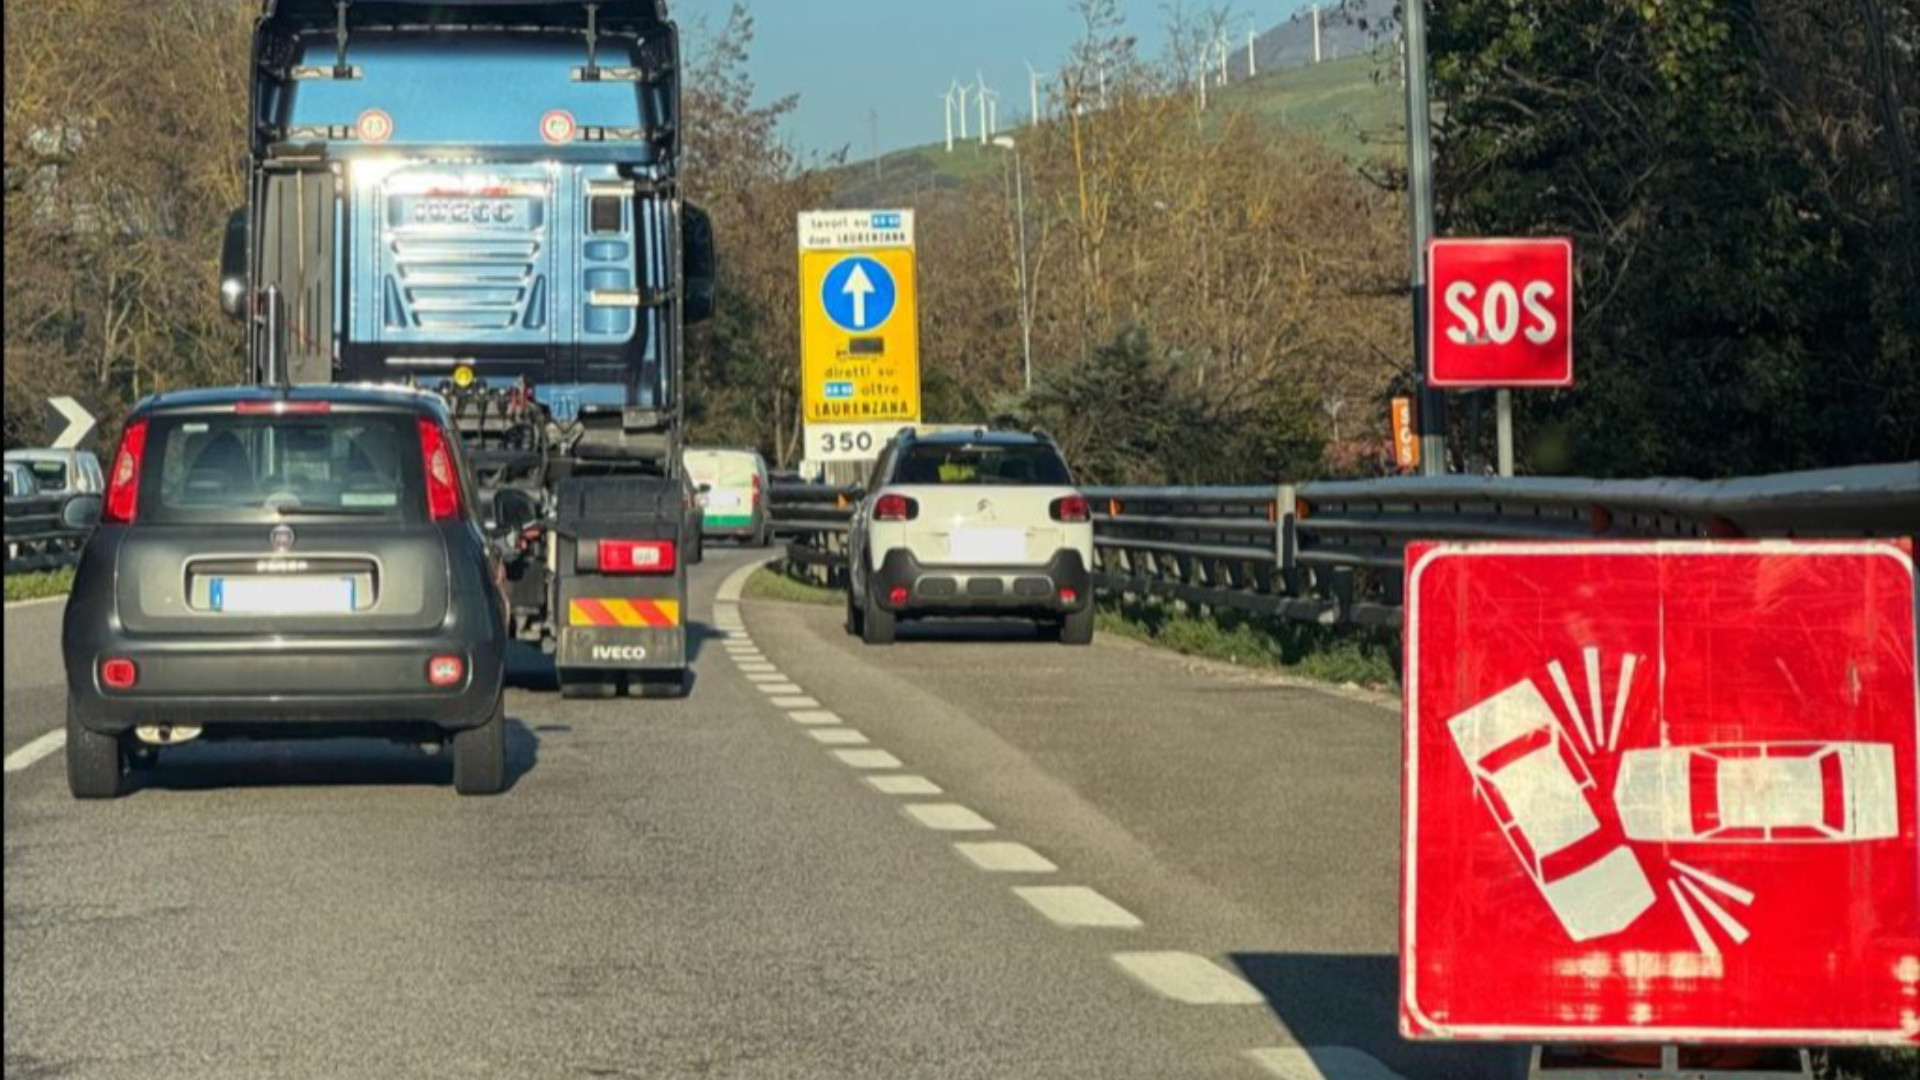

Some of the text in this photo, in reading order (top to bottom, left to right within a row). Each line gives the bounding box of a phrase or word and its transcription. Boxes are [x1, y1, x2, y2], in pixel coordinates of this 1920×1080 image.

[1444, 280, 1557, 344] SOS
[860, 382, 899, 397] oltre
[814, 401, 909, 417] LAURENZANA
[821, 431, 872, 453] 350
[592, 645, 646, 660] IVECO
